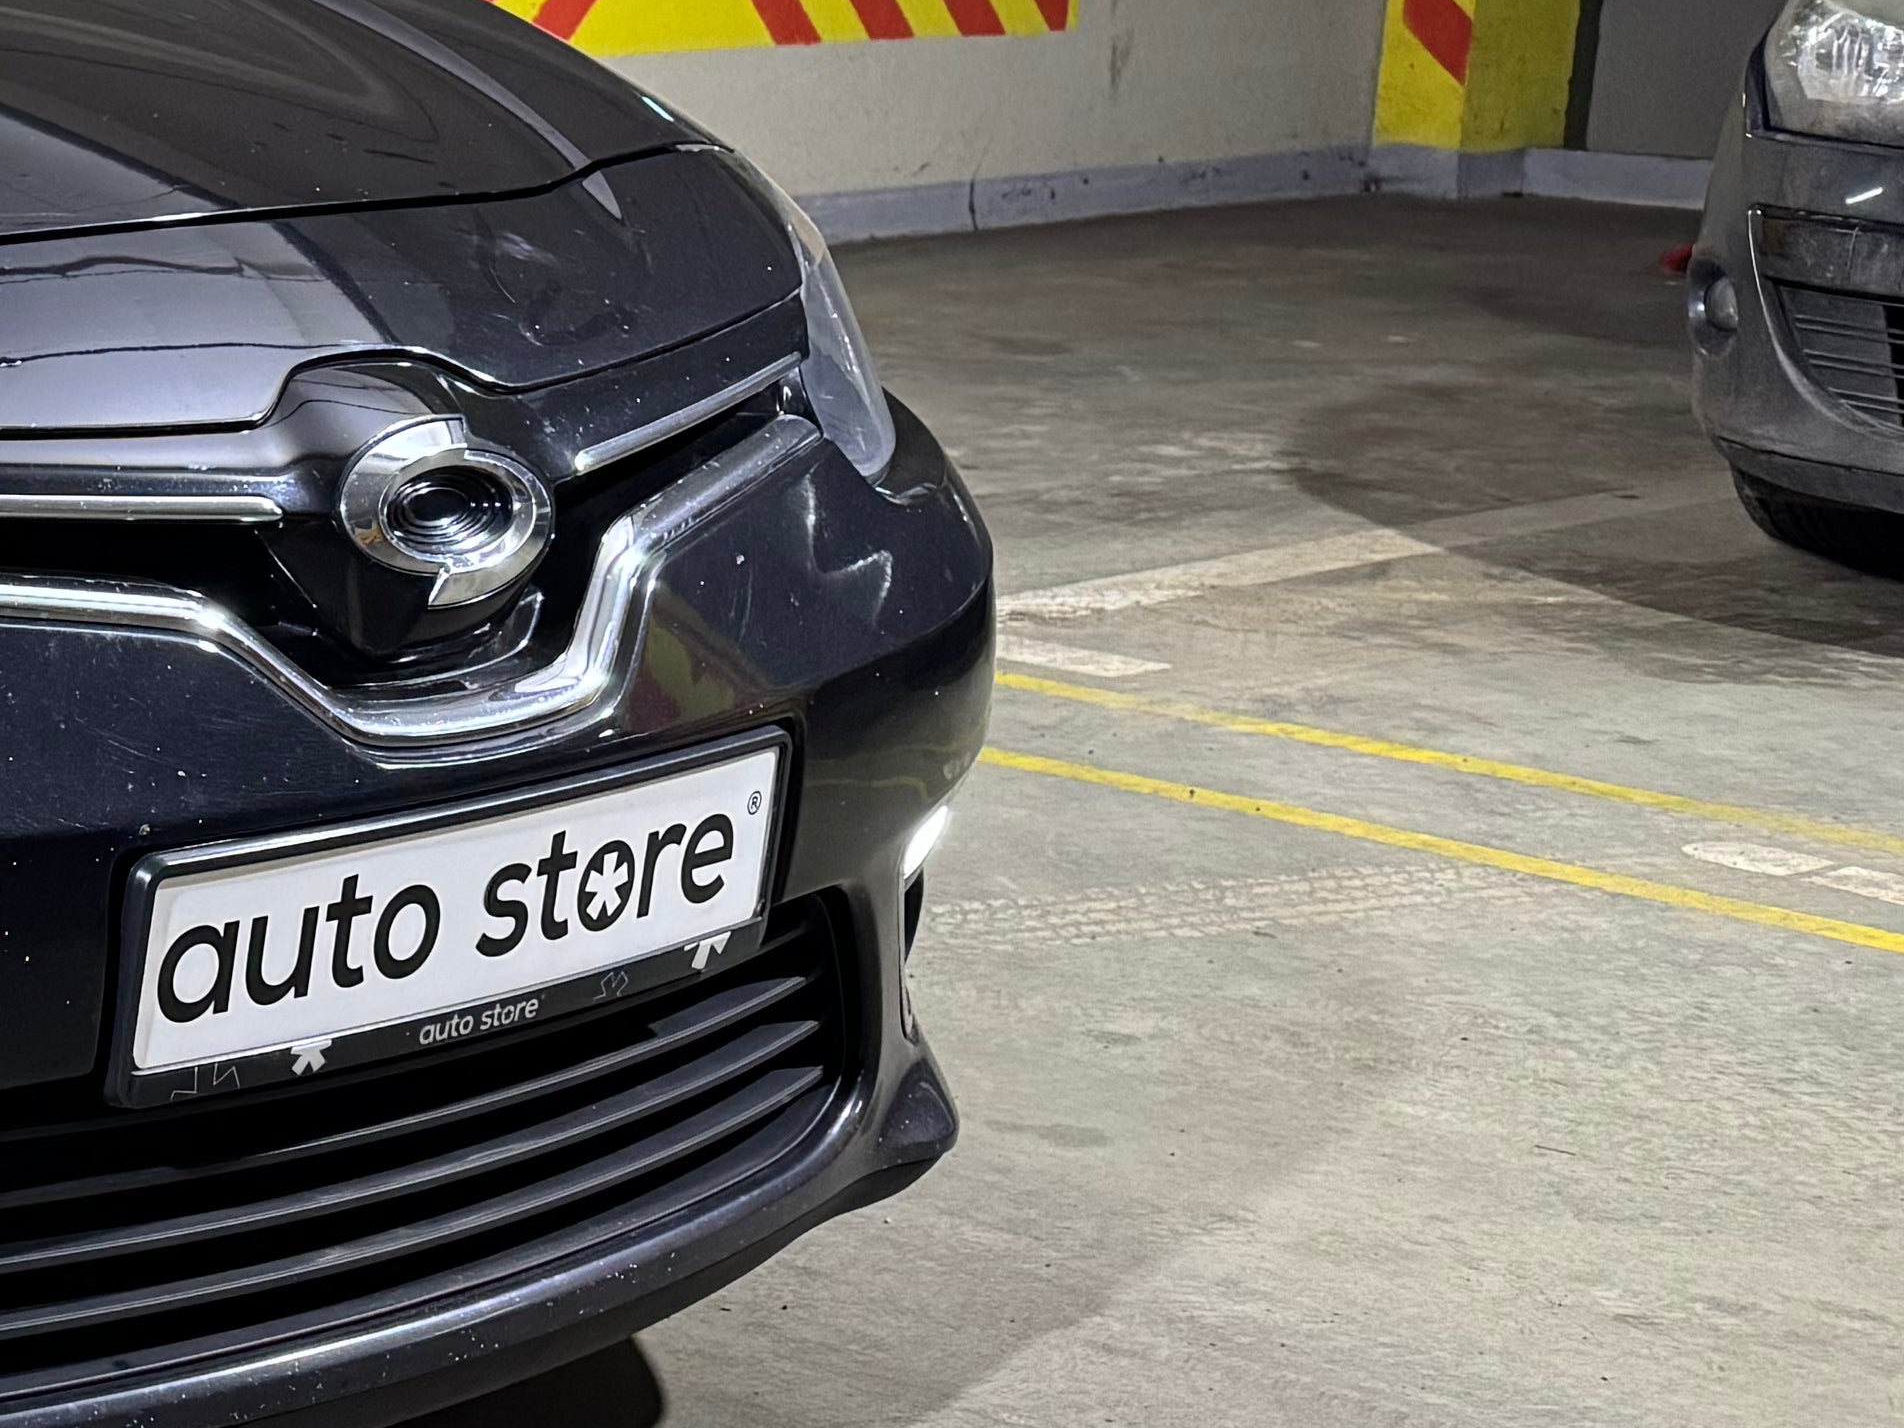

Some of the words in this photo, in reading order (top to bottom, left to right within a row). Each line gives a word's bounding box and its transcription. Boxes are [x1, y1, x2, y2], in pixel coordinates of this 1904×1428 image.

[156, 873, 440, 1023] auto
[476, 812, 734, 958] store
[419, 1014, 474, 1045] auto
[480, 998, 539, 1030] store
